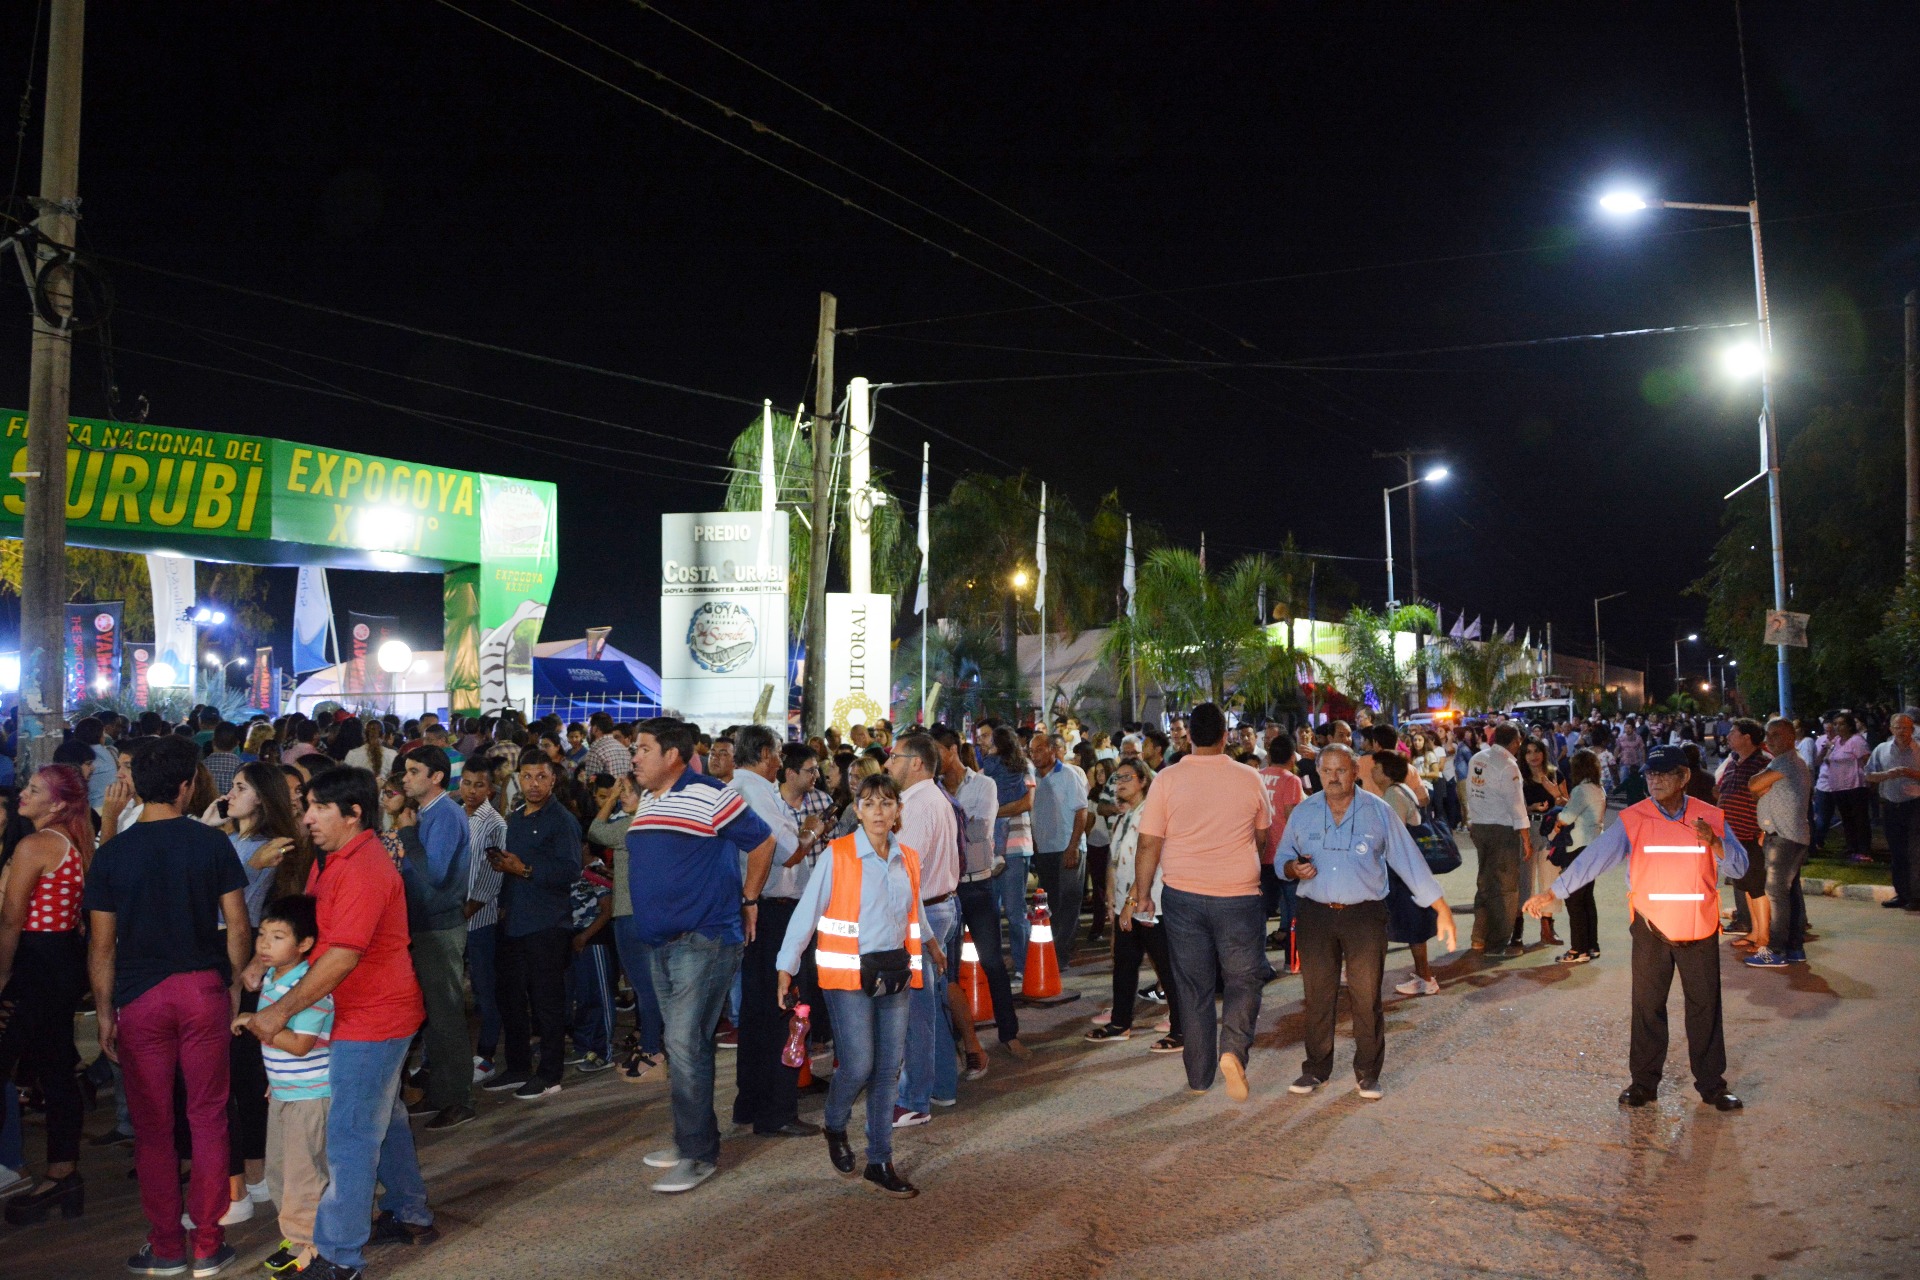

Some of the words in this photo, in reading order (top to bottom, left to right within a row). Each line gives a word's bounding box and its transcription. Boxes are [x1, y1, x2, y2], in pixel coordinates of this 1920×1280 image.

[6, 417, 92, 446] FITA
[102, 427, 216, 458] NACIONAL
[225, 440, 264, 462] DEL
[287, 448, 474, 516] EXPOGOYA
[500, 480, 533, 496] GOYA
[694, 525, 751, 541] PREDIO
[496, 569, 543, 584] EXPOGOYA
[664, 560, 719, 583] COSTA
[723, 559, 784, 583] SURUBI
[704, 602, 740, 615] GOYA
[71, 615, 82, 633] THE
[72, 635, 84, 661] SPIRIT
[849, 603, 866, 691] LITORAL
[96, 631, 114, 699] YAMA
